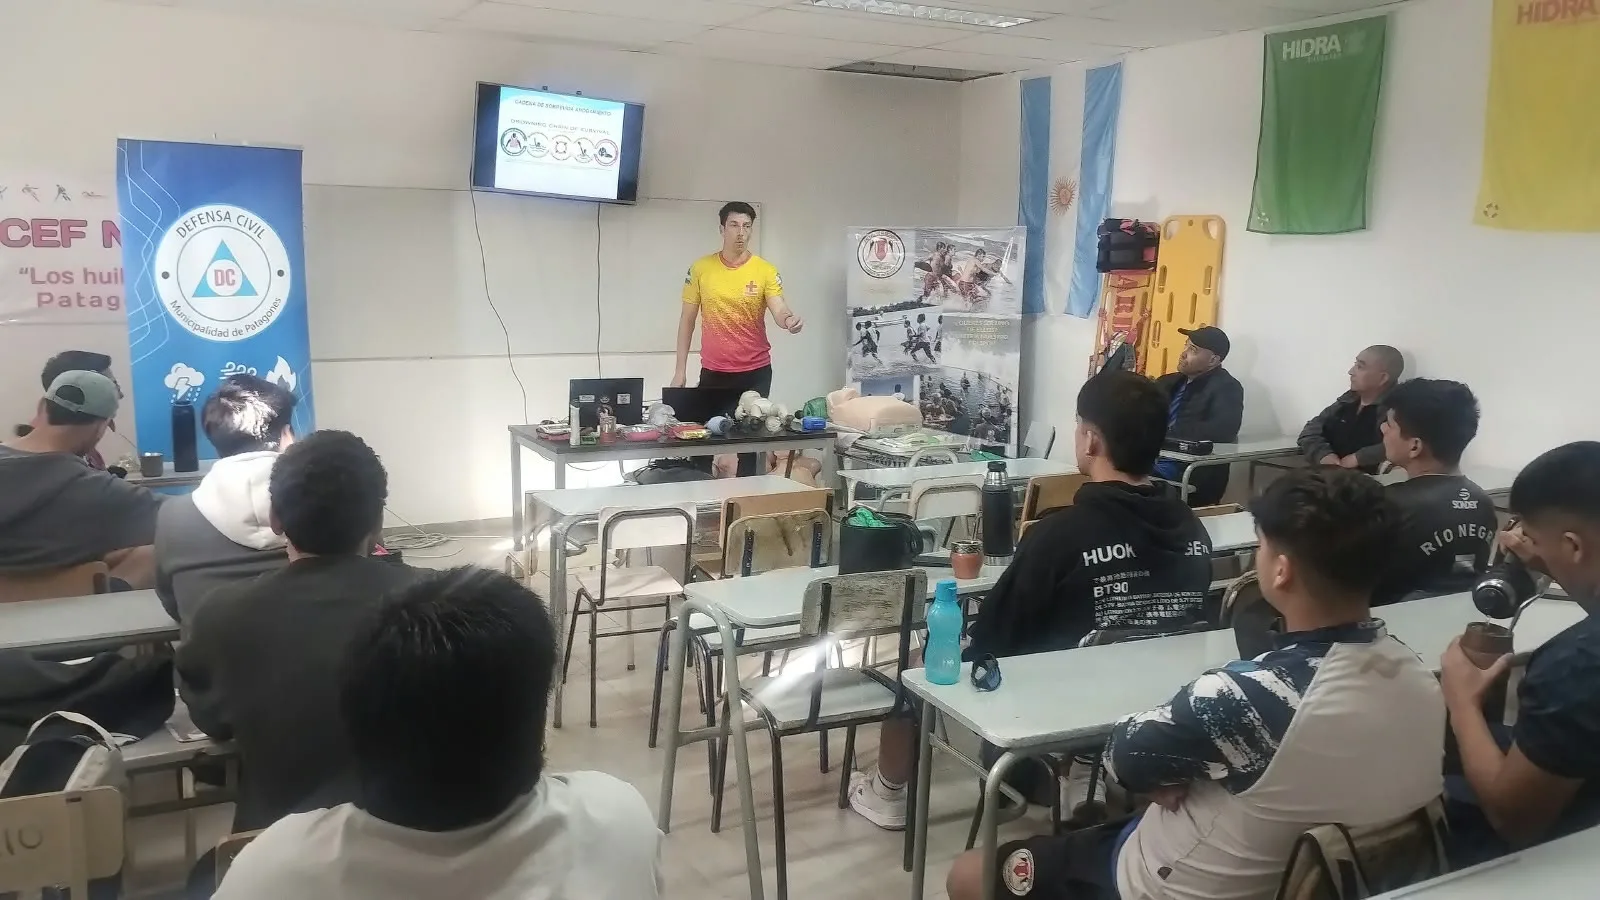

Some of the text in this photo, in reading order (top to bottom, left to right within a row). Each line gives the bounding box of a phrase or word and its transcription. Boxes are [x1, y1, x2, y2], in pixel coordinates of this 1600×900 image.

[1517, 0, 1600, 25] HIDRA
[1283, 34, 1341, 60] HIDRA
[0, 218, 88, 249] CEF
[176, 210, 266, 240] DEFENSA CIVIL
[213, 268, 236, 287] DC
[170, 297, 282, 338] Municipalidad de Patagones
[1420, 529, 1454, 556] RÍO
[1093, 582, 1129, 598] BT90
